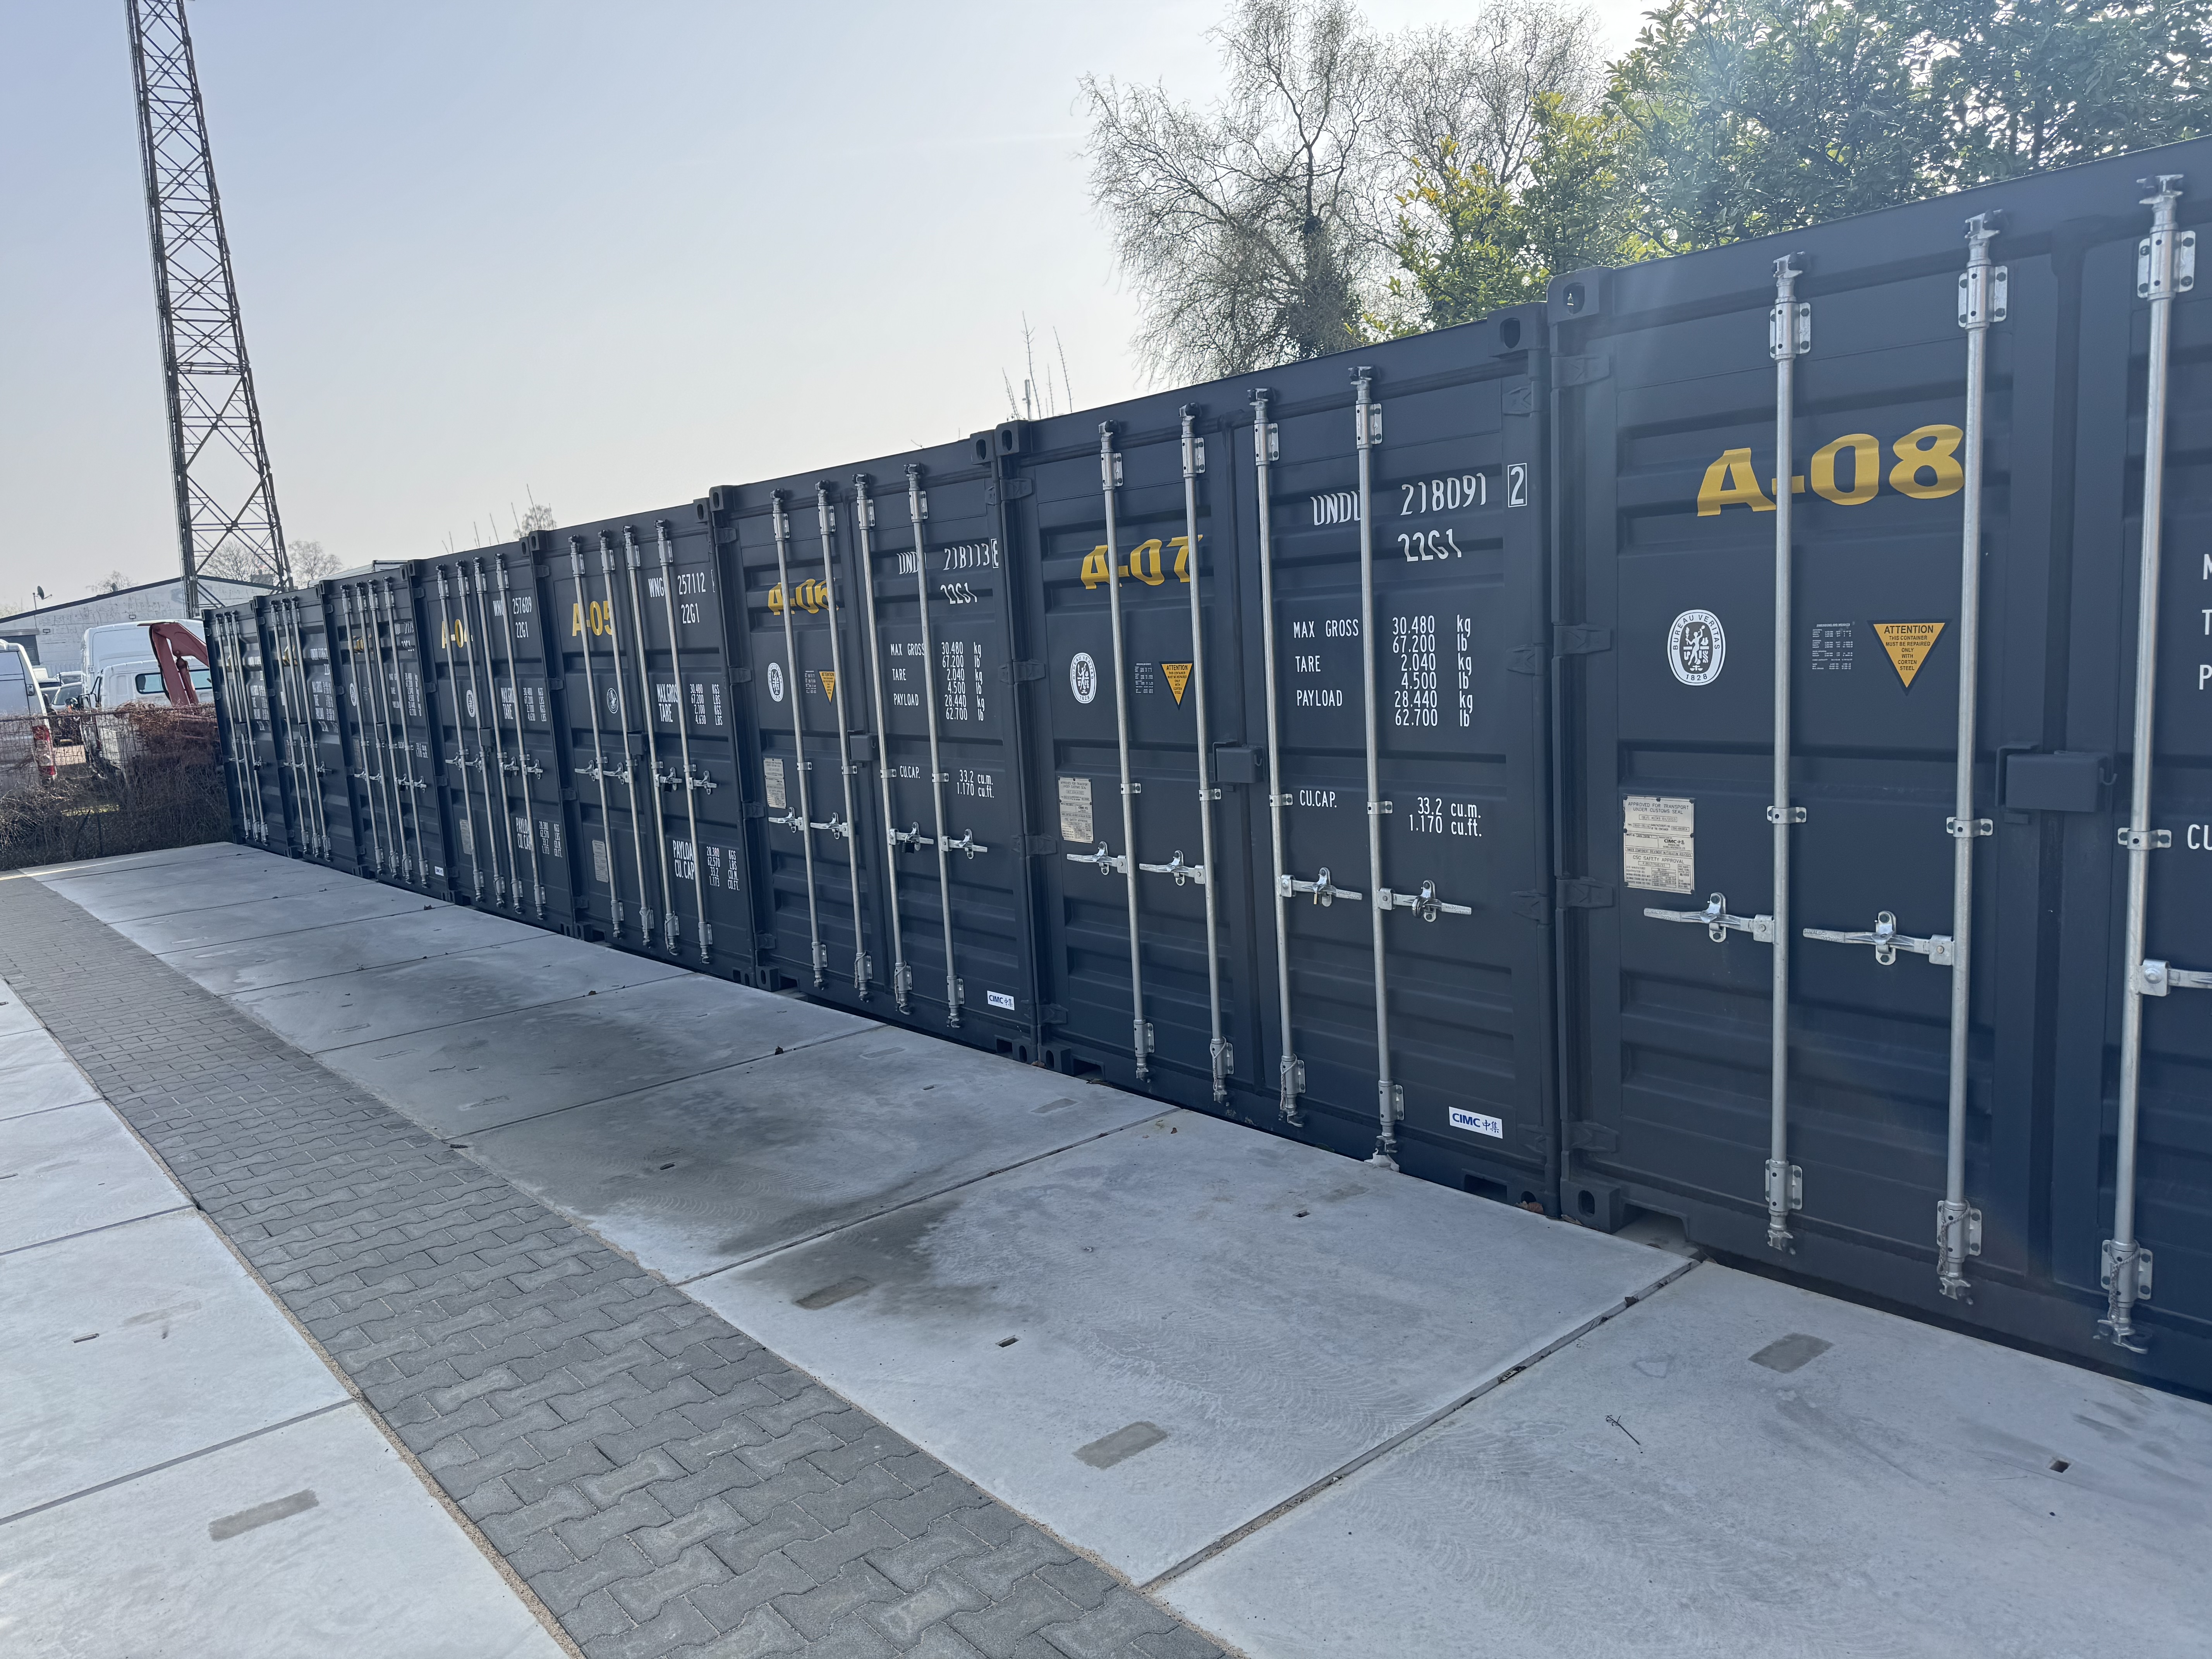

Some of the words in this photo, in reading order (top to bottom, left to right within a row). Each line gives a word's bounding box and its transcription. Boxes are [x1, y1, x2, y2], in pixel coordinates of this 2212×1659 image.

[1697, 424, 1964, 516] A-08
[1400, 473, 1486, 515] 218091
[1510, 466, 1524, 505] 2
[1398, 529, 1462, 562] 22G1
[896, 551, 927, 575] UND
[943, 543, 990, 570] 218113
[1081, 534, 1203, 589] A-07
[648, 577, 665, 598] WNG
[678, 572, 706, 595] 257112
[940, 582, 977, 604] 22G1
[512, 596, 532, 614] 257609
[681, 603, 700, 624] 22G1
[515, 621, 529, 638] 22G1
[1293, 621, 1315, 639] MAX
[1325, 619, 1359, 637] GROSS
[1457, 614, 1471, 638] kg
[1673, 615, 1693, 650] BUREAU
[1698, 615, 1720, 649] VERITAS
[1884, 625, 1934, 634] ATTENTION
[891, 643, 903, 656] MAX
[907, 643, 925, 656] GROSS
[974, 642, 981, 658] kg
[1457, 634, 1468, 652] lb
[974, 655, 980, 668] lb
[1295, 655, 1321, 672] TARE
[1458, 653, 1472, 676] kg
[892, 668, 907, 681] TARE
[975, 668, 983, 685] kg
[1458, 672, 1469, 689] lb
[976, 682, 982, 694] lb
[503, 703, 513, 719] TARE
[893, 693, 919, 706] PAYLOAD
[977, 695, 985, 712] kg
[1297, 690, 1343, 707] PAYLOAD
[1459, 690, 1473, 714] kg
[659, 703, 673, 722] TARE
[714, 705, 722, 715] KGS
[715, 715, 723, 726] LBS
[978, 708, 984, 721] lb
[1460, 709, 1470, 727] lb
[900, 765, 920, 779] CU.CAP.
[959, 769, 974, 783] 33.2
[977, 774, 993, 785] cu.m.
[978, 785, 994, 798] cu.ft.
[1300, 790, 1337, 808] CU.CAP.
[1417, 797, 1443, 816] 33.2
[1450, 803, 1481, 818] cu.m.
[1451, 818, 1482, 837] cu.ft.
[673, 840, 694, 861] PAYLOA
[729, 859, 737, 871] LBS
[989, 995, 1003, 1004] CIMC
[1452, 1113, 1480, 1128] CIMC
[1482, 1119, 1499, 1133] 中集
